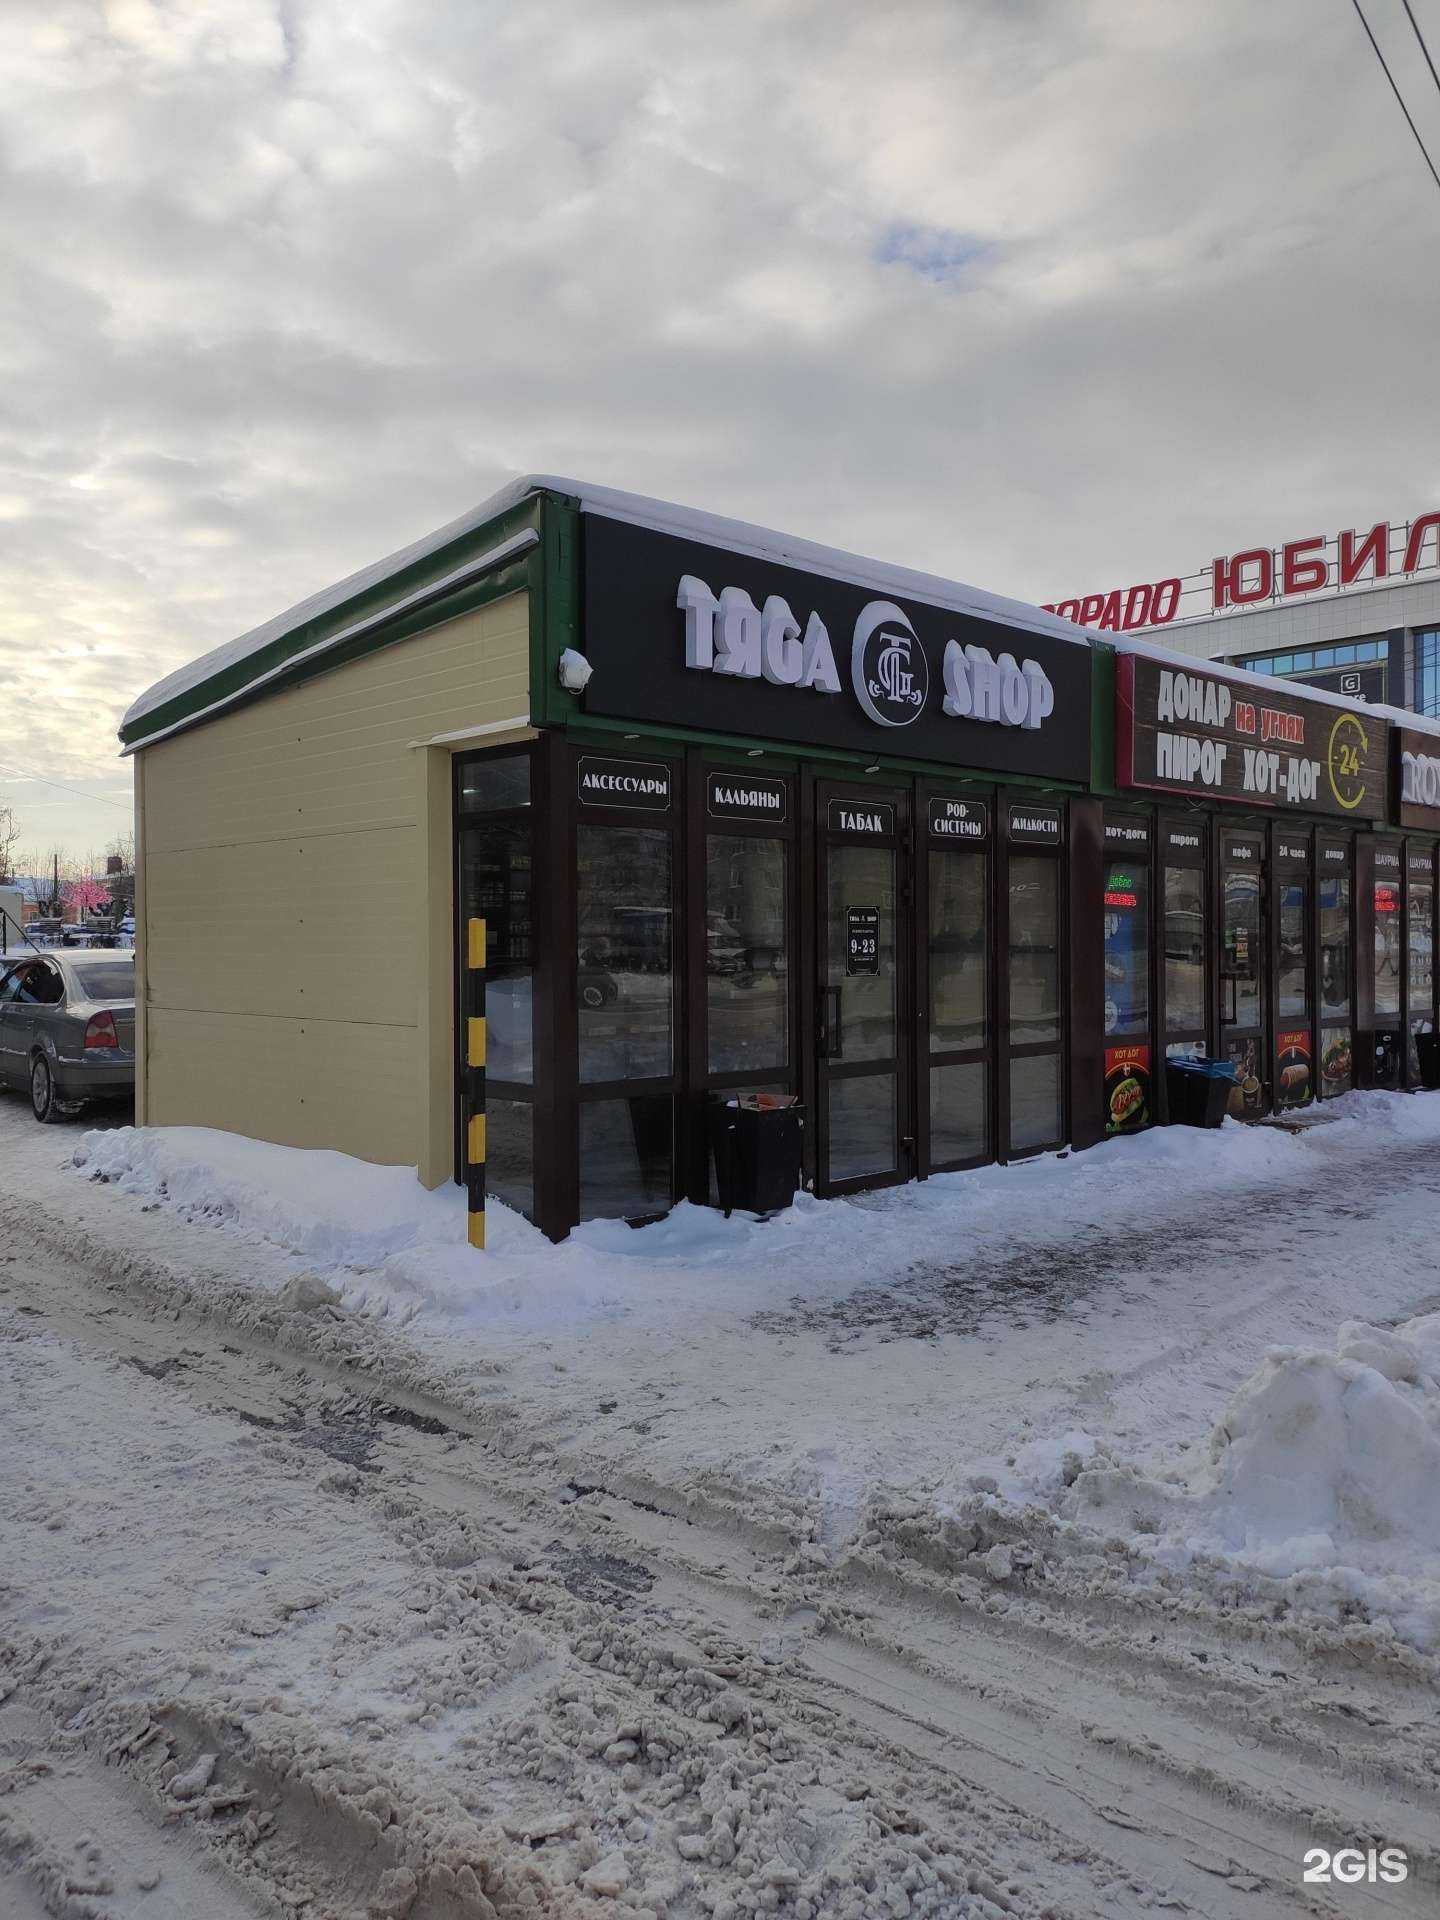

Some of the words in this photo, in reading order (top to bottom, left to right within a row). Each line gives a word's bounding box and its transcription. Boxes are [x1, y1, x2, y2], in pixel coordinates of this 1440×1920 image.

[943, 640, 1055, 729] SHOP
[1158, 670, 1231, 727] ДОНАР
[1235, 701, 1256, 734] на
[1157, 732, 1227, 785] ПИРОГ
[1243, 748, 1321, 803] ХОТ-ДОГ
[1339, 744, 1360, 776] 24
[582, 773, 667, 794] АКСЕССУАРЫ
[715, 787, 780, 809] КАЛЬЯНЫ
[839, 811, 883, 832] ТАБАК
[934, 819, 982, 836] СИСТЕМЫ
[1012, 817, 1058, 833] ЖИДКОСТИ
[1169, 834, 1200, 847] пироги
[1374, 853, 1400, 867] ШАУРМА
[1409, 857, 1433, 870] ШАУРМА
[850, 938, 876, 954] 9-23
